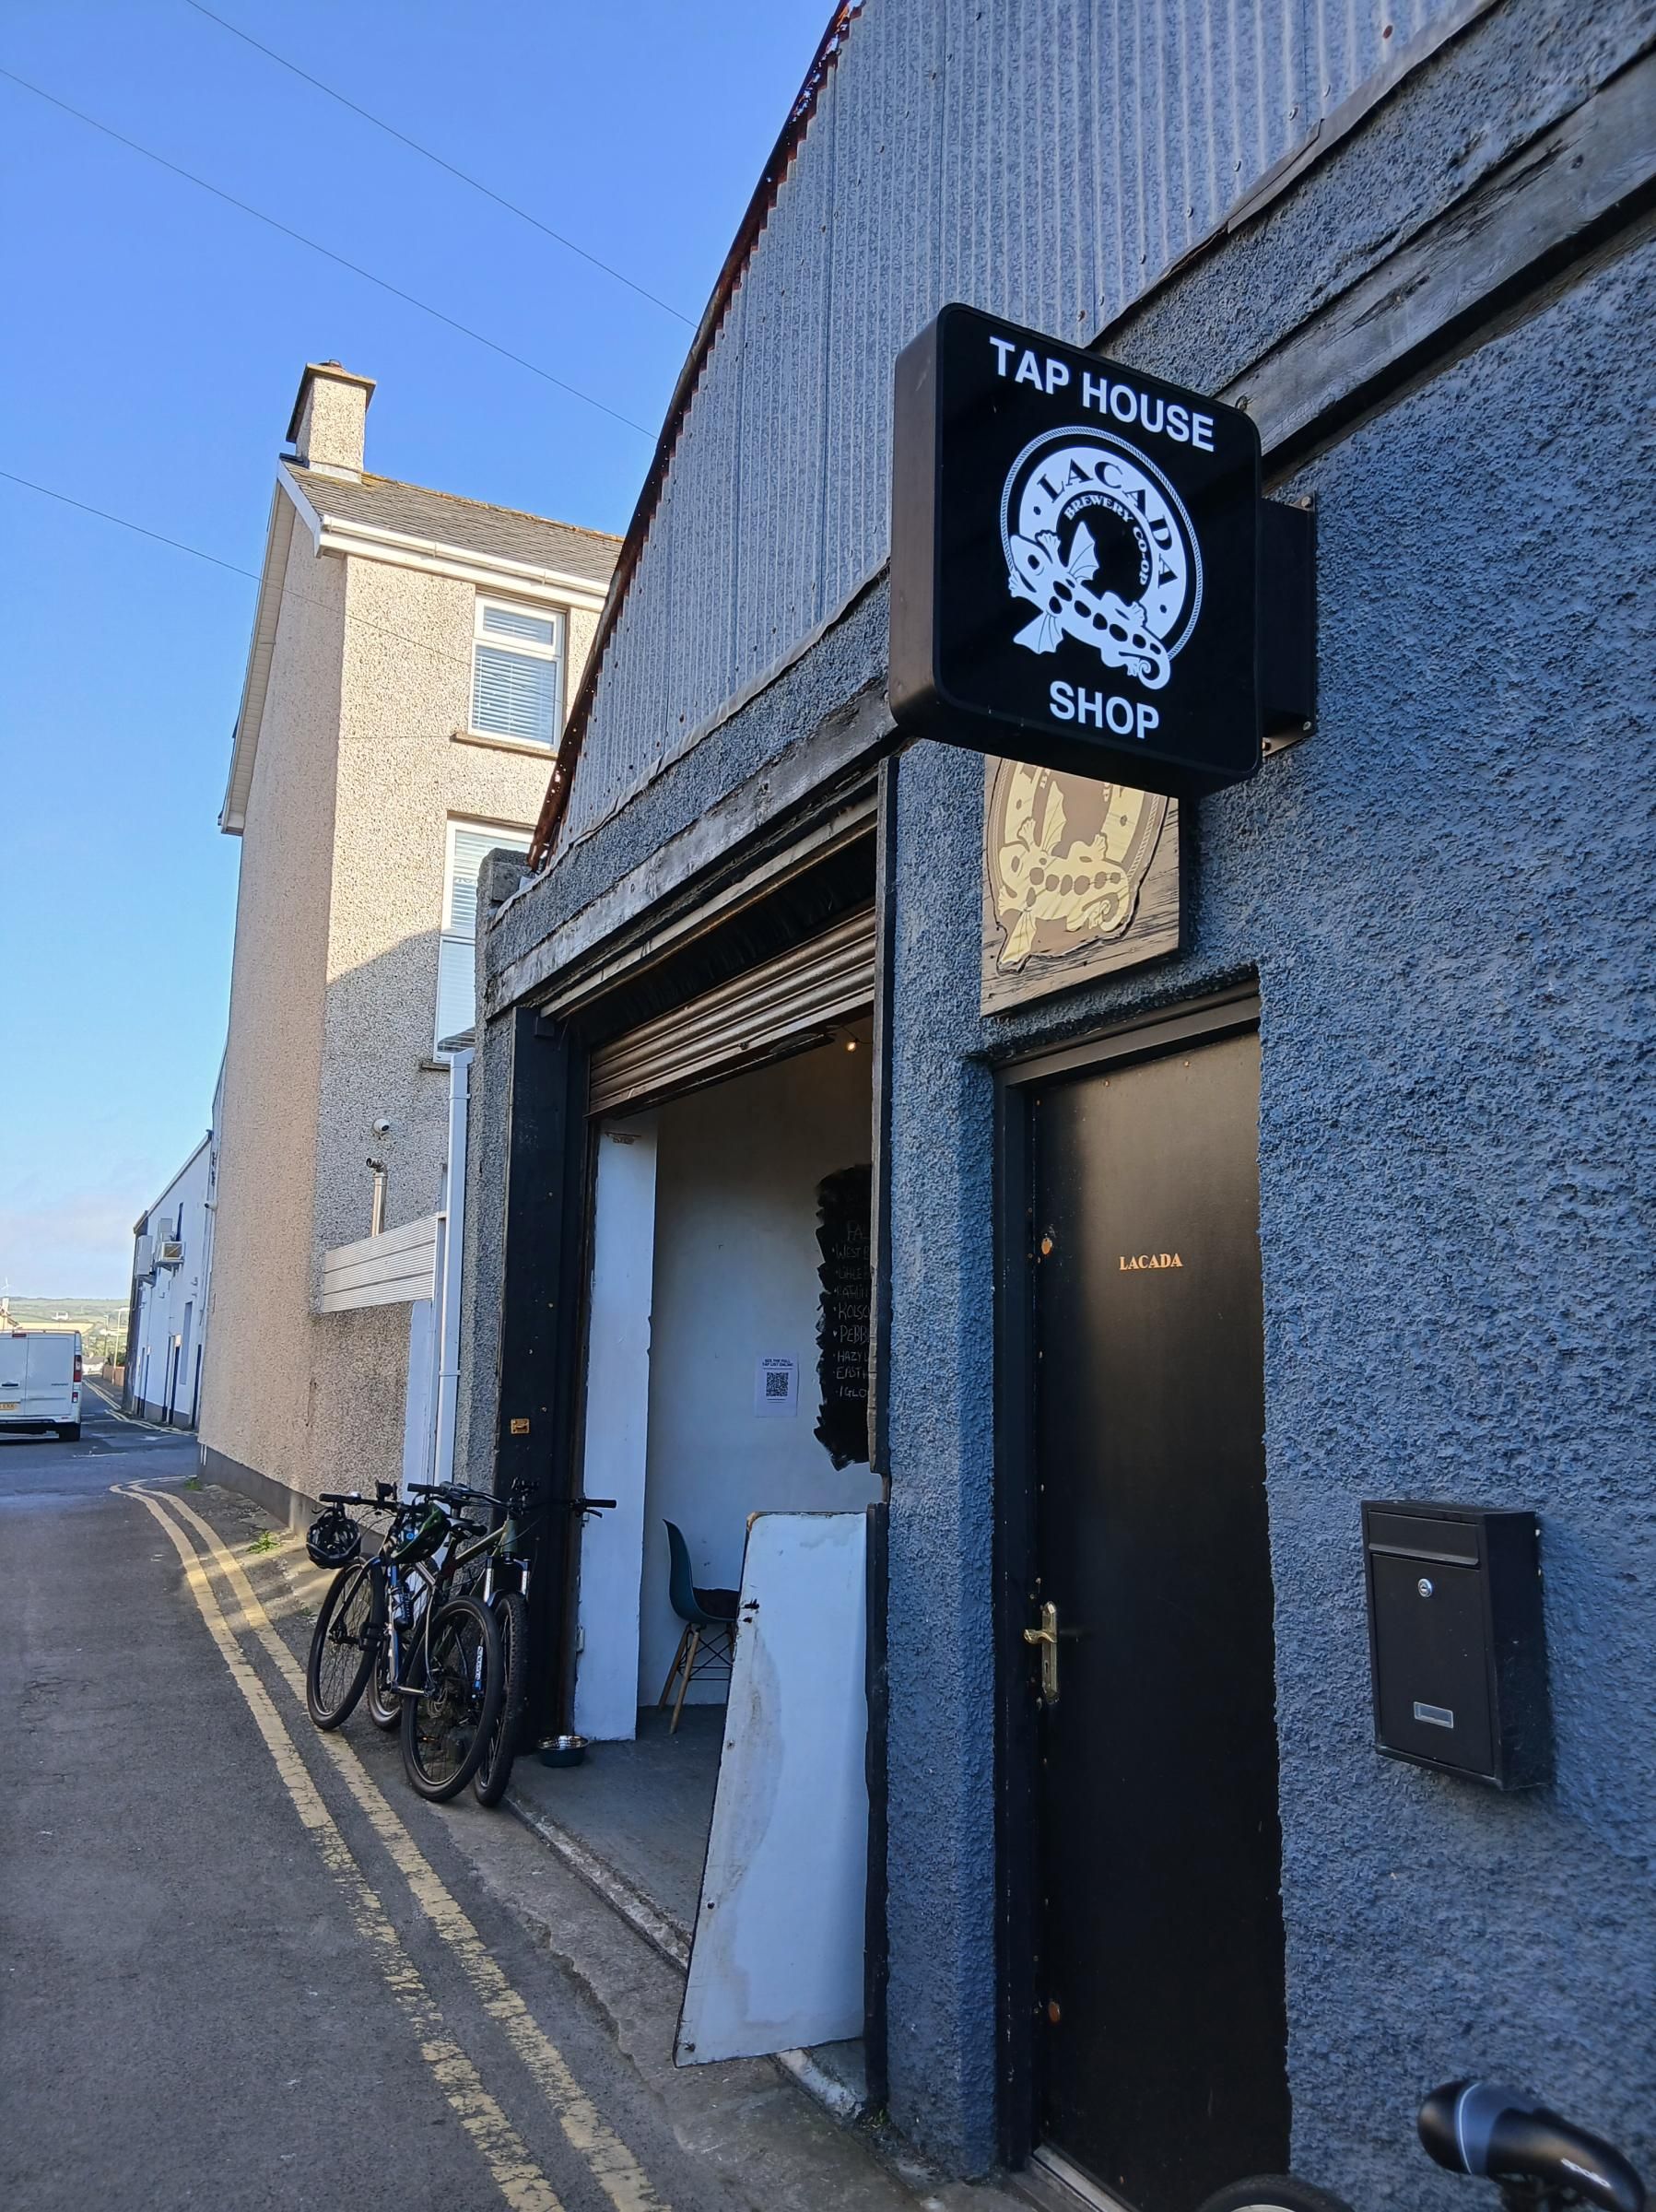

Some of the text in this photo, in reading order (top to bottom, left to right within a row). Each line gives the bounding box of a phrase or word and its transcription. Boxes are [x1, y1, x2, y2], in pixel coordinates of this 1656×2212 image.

[990, 336, 1215, 453] TAP HOUSE
[1037, 458, 1179, 589] LACADA
[1063, 494, 1150, 586] BREWERY CO-OP
[1050, 680, 1159, 739] SHOP
[1119, 1253, 1183, 1271] LACADA
[839, 1301, 871, 1320] KOLSC
[840, 1324, 870, 1344] PEBB
[838, 1349, 862, 1362] HAZY
[836, 1366, 862, 1381] EAST
[840, 1385, 867, 1399] IGLO
